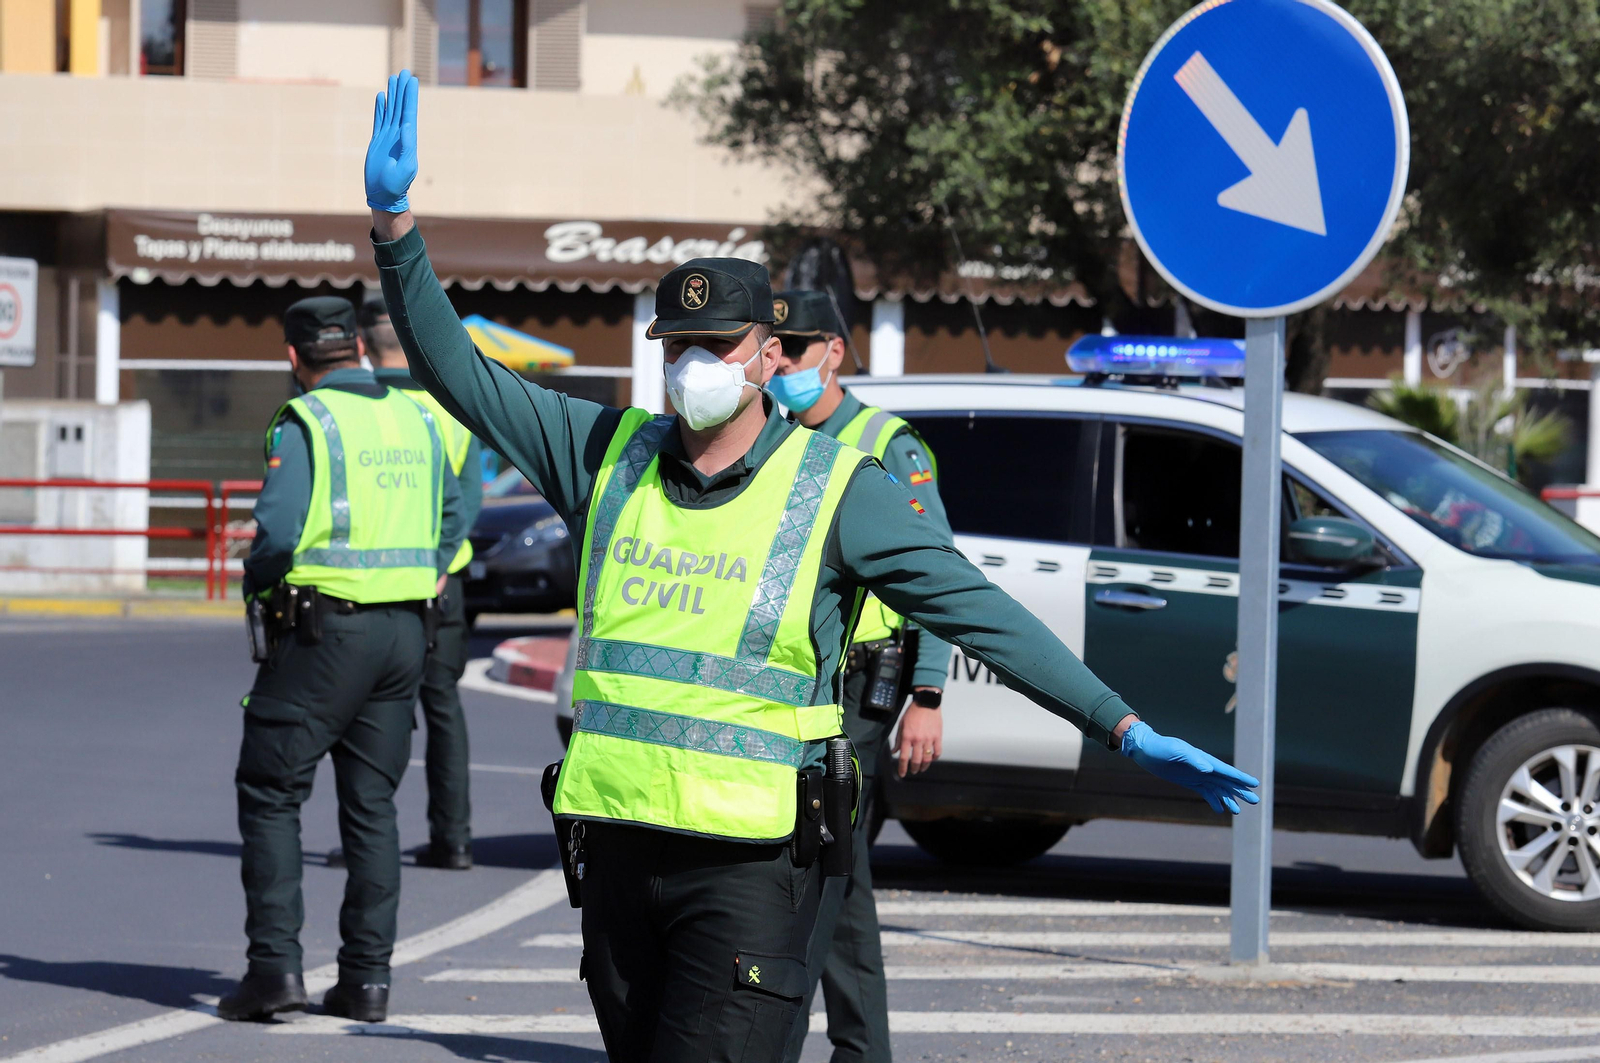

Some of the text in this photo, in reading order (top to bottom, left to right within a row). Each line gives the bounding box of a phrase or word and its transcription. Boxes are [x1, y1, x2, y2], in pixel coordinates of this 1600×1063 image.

[197, 213, 294, 240] Desayunos
[134, 234, 356, 263] Tapas y Platos elaborados
[358, 450, 427, 467] GUARDIA
[376, 471, 419, 489] CIVIL
[613, 536, 747, 583] GUARDIA
[621, 576, 706, 615] CIVIL
